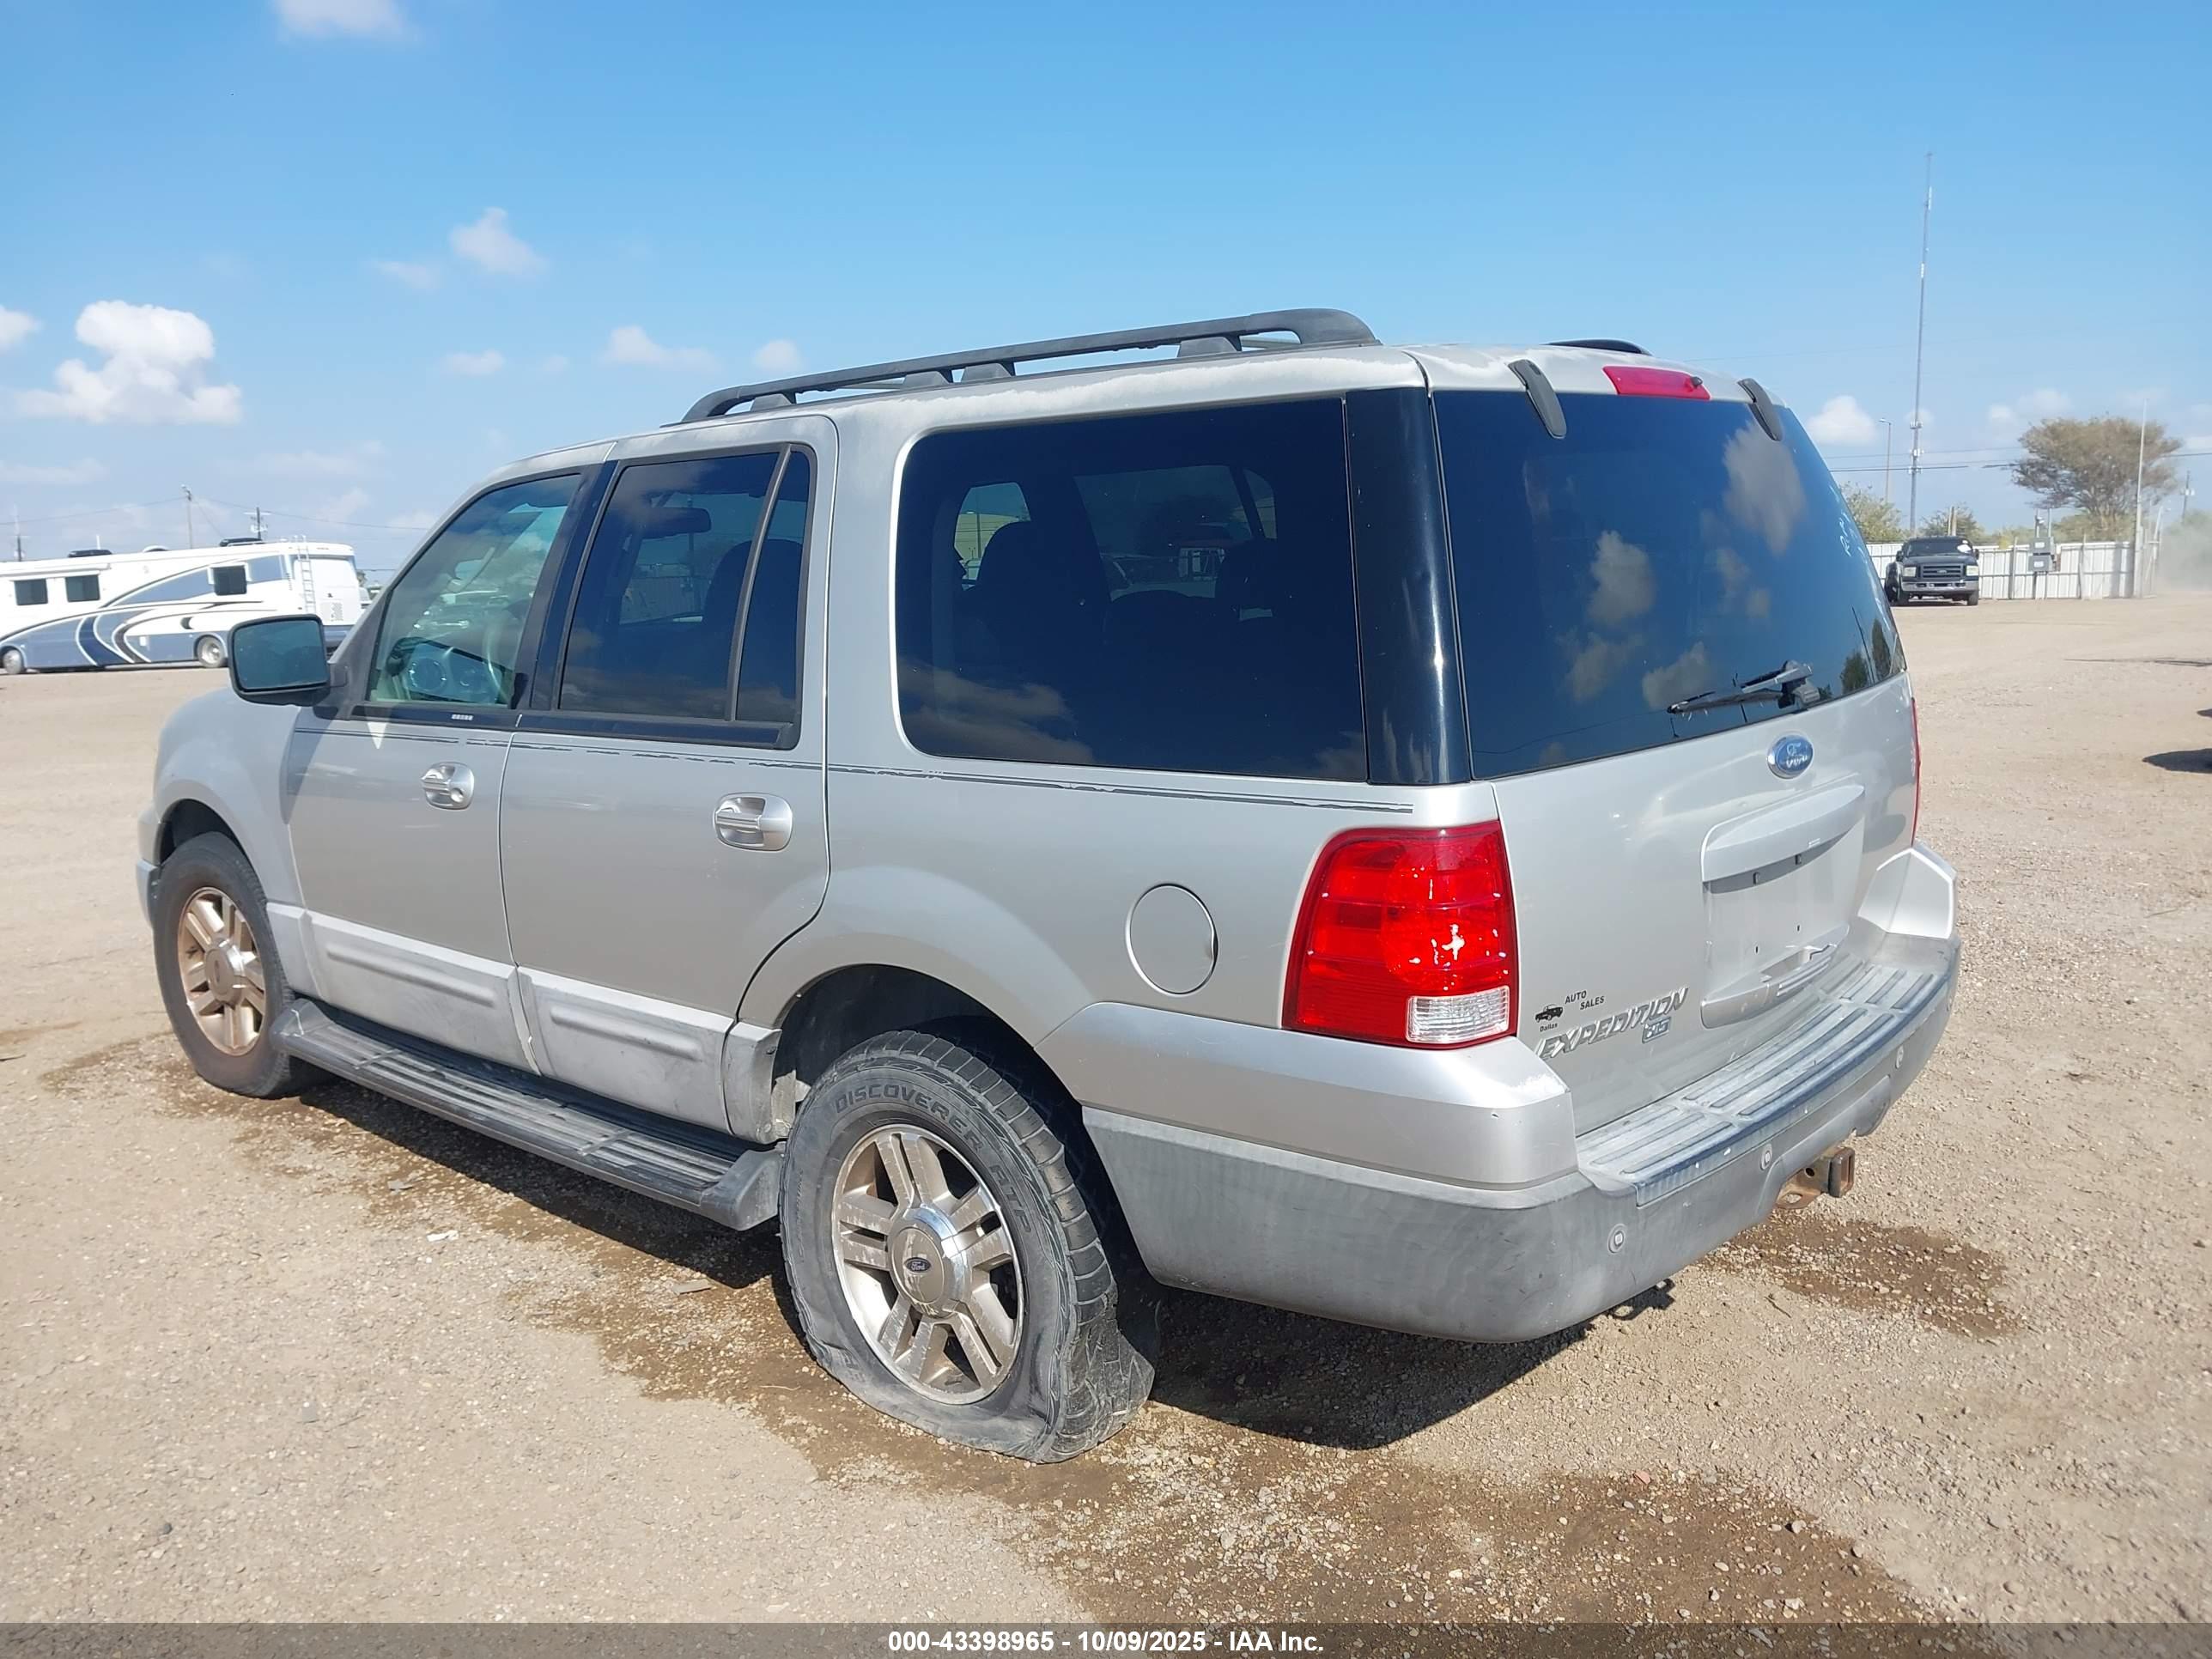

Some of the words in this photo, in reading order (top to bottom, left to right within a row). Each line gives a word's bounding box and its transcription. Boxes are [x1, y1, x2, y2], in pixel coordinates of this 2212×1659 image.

[1565, 989, 1587, 1005] AUTO
[1580, 995, 1605, 1011] SALES
[1537, 987, 1689, 1059] EXPEDITION
[1540, 1023, 1558, 1033] Dallas
[835, 1084, 985, 1153] DISCOVERER
